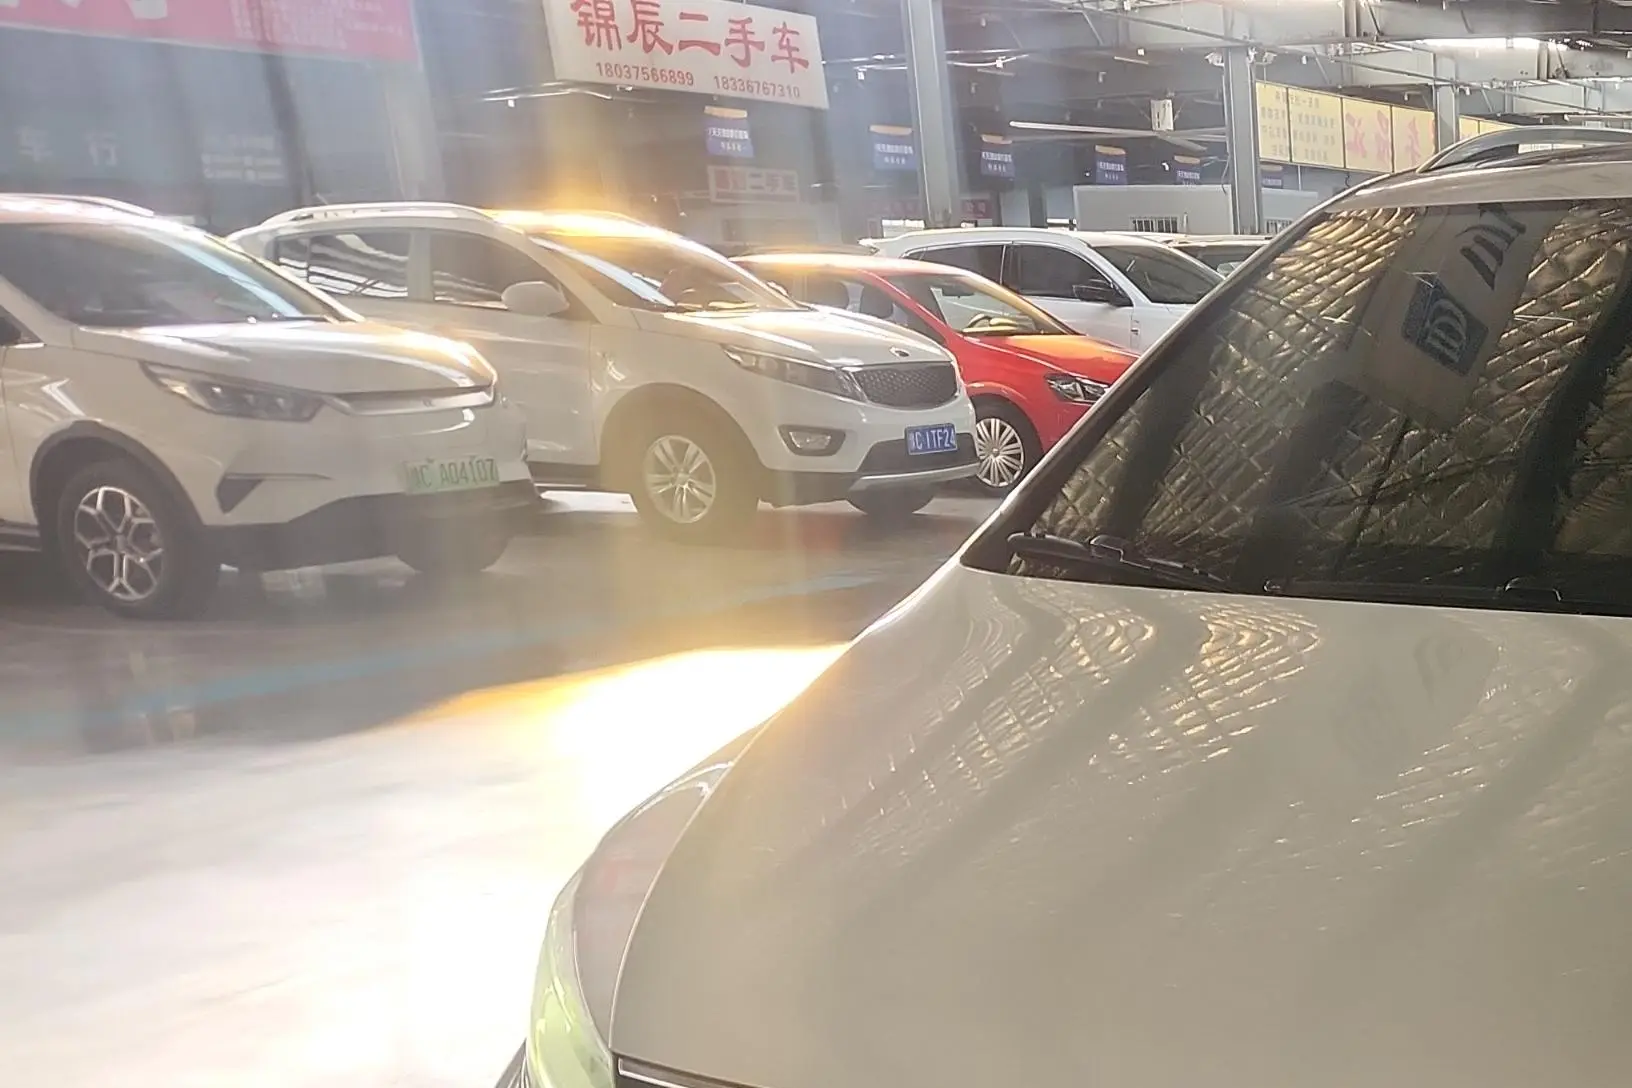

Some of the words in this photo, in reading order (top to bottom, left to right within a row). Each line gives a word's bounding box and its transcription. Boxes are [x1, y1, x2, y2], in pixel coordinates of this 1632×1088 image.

[570, 0, 809, 73] 锦辰二手车
[596, 62, 694, 86] 18037566899
